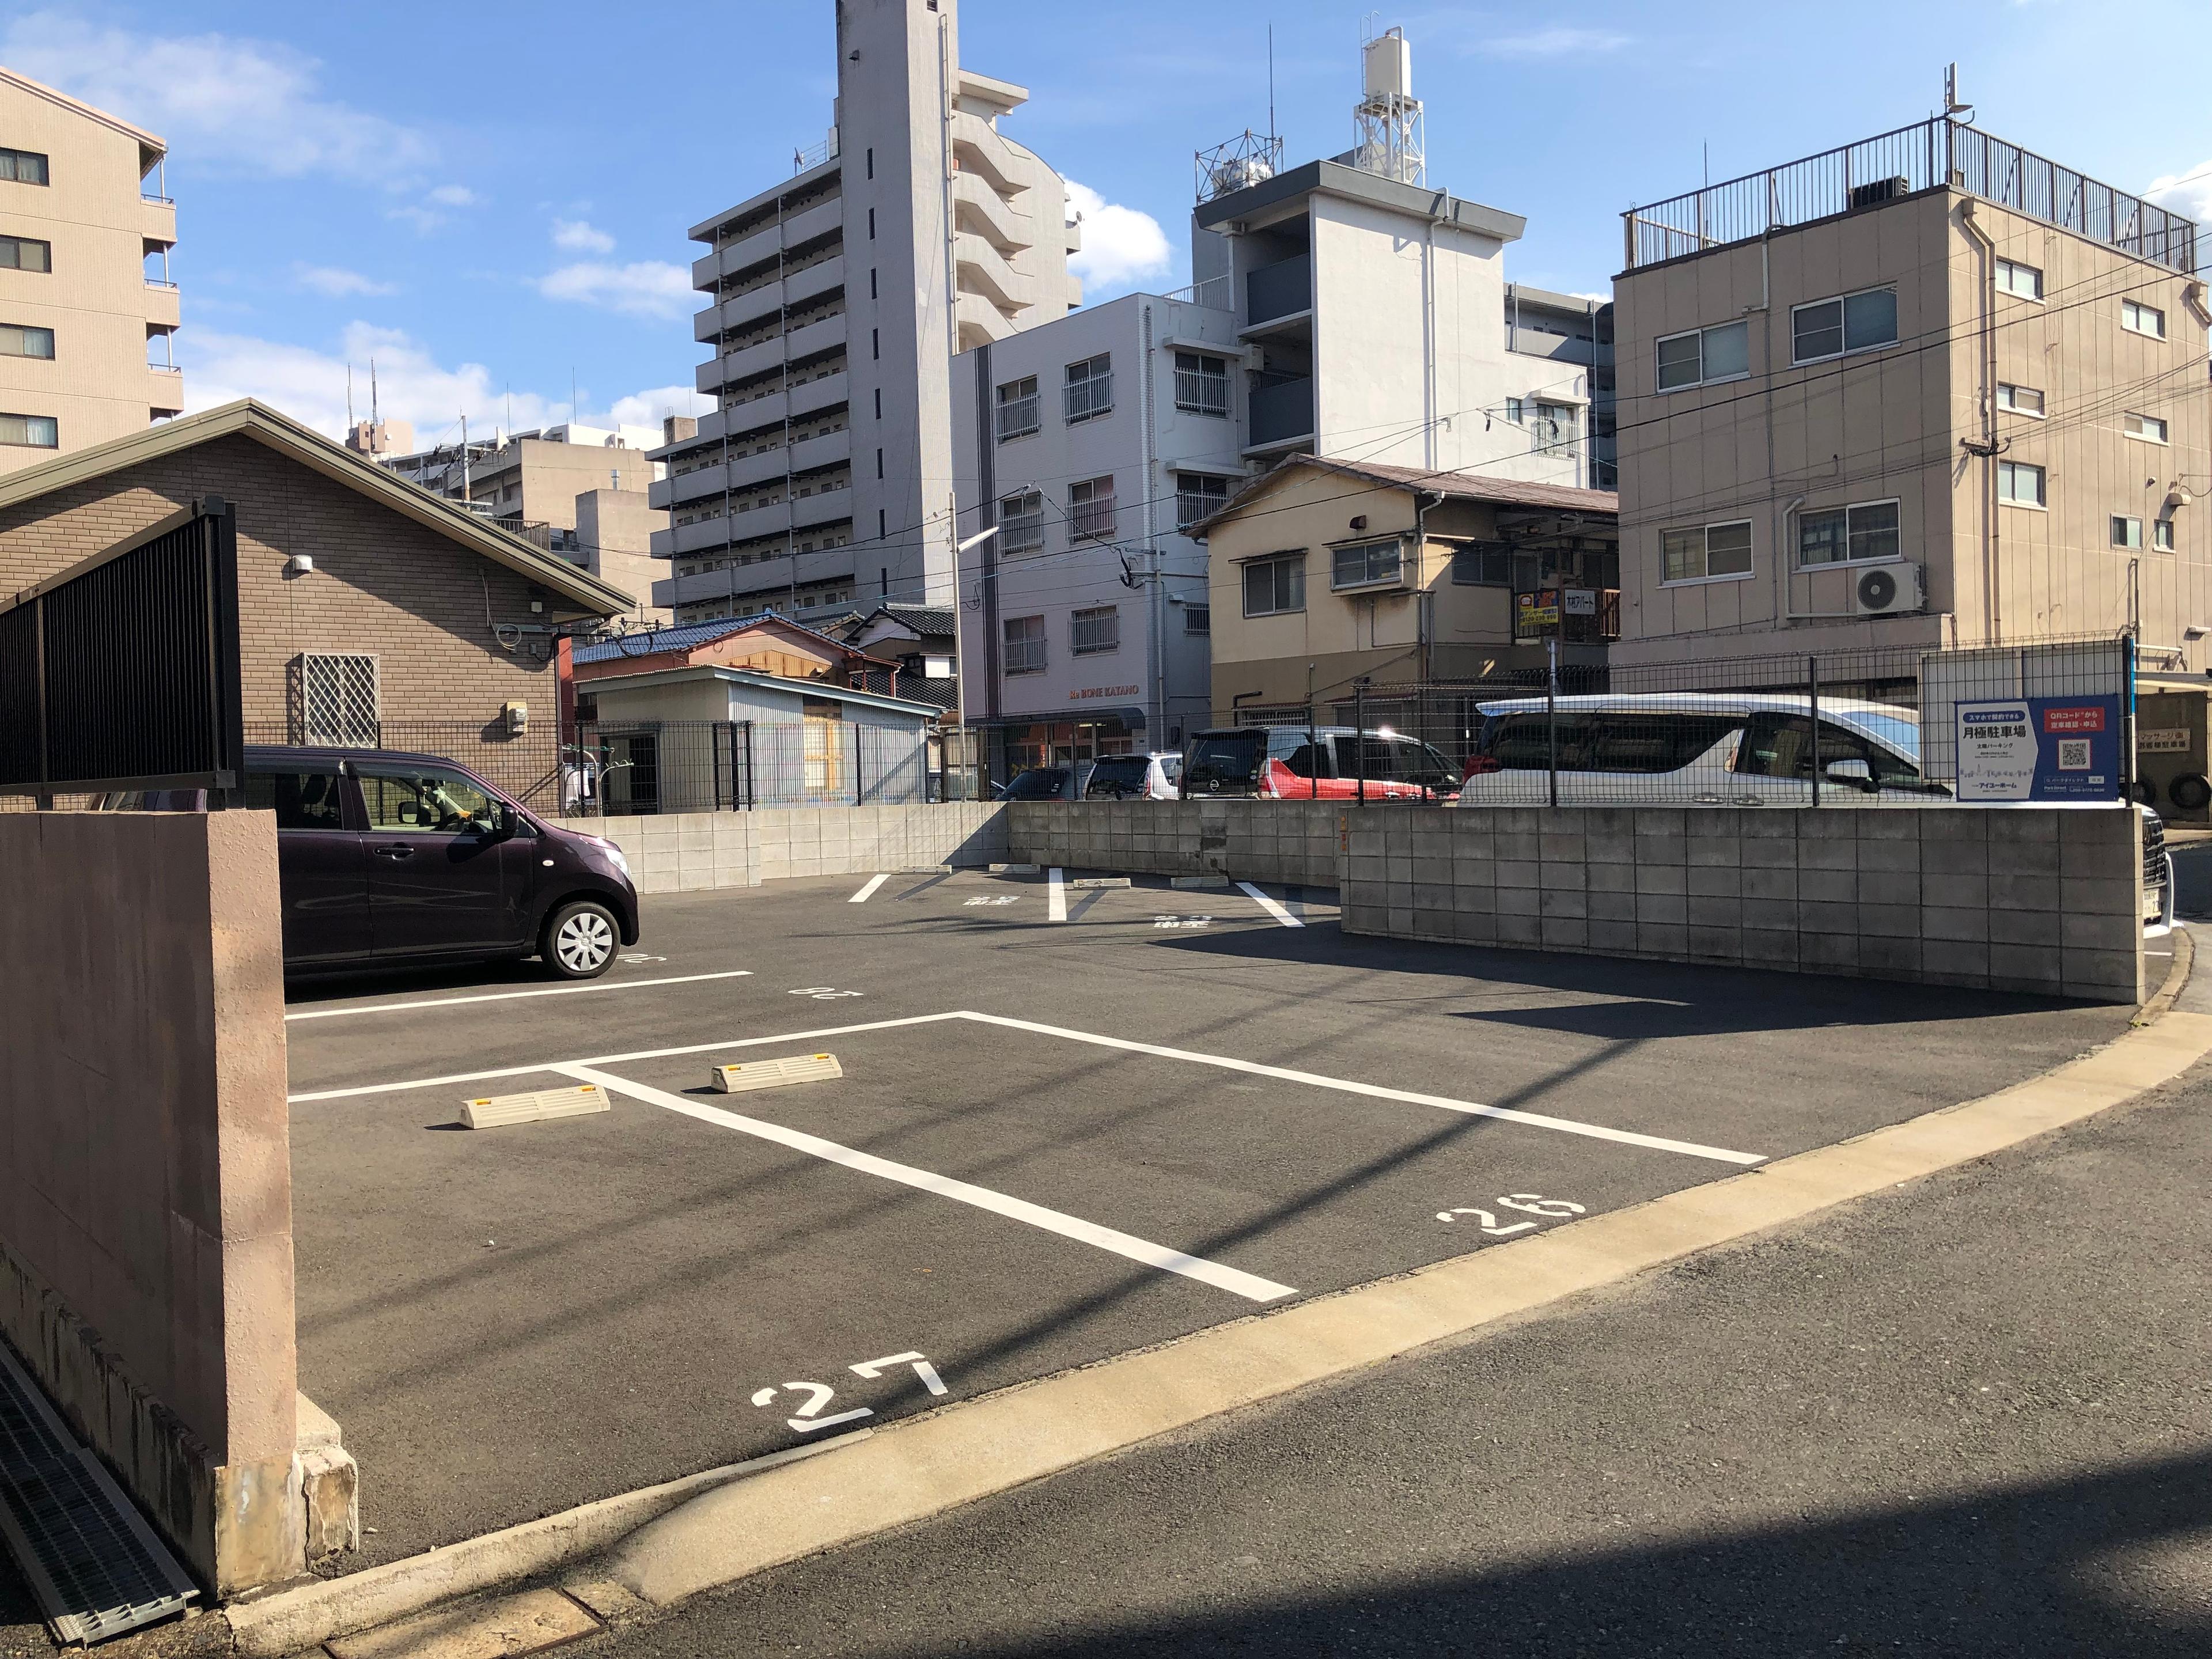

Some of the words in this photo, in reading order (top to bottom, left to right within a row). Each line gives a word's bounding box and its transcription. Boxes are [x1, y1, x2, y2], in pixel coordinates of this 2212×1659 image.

[1081, 688, 1103, 699] BONE
[1105, 684, 1139, 697] KATANO
[1963, 725, 2027, 738] 月極駐車場
[1435, 1194, 1586, 1235] 26
[751, 1351, 949, 1433] 27
